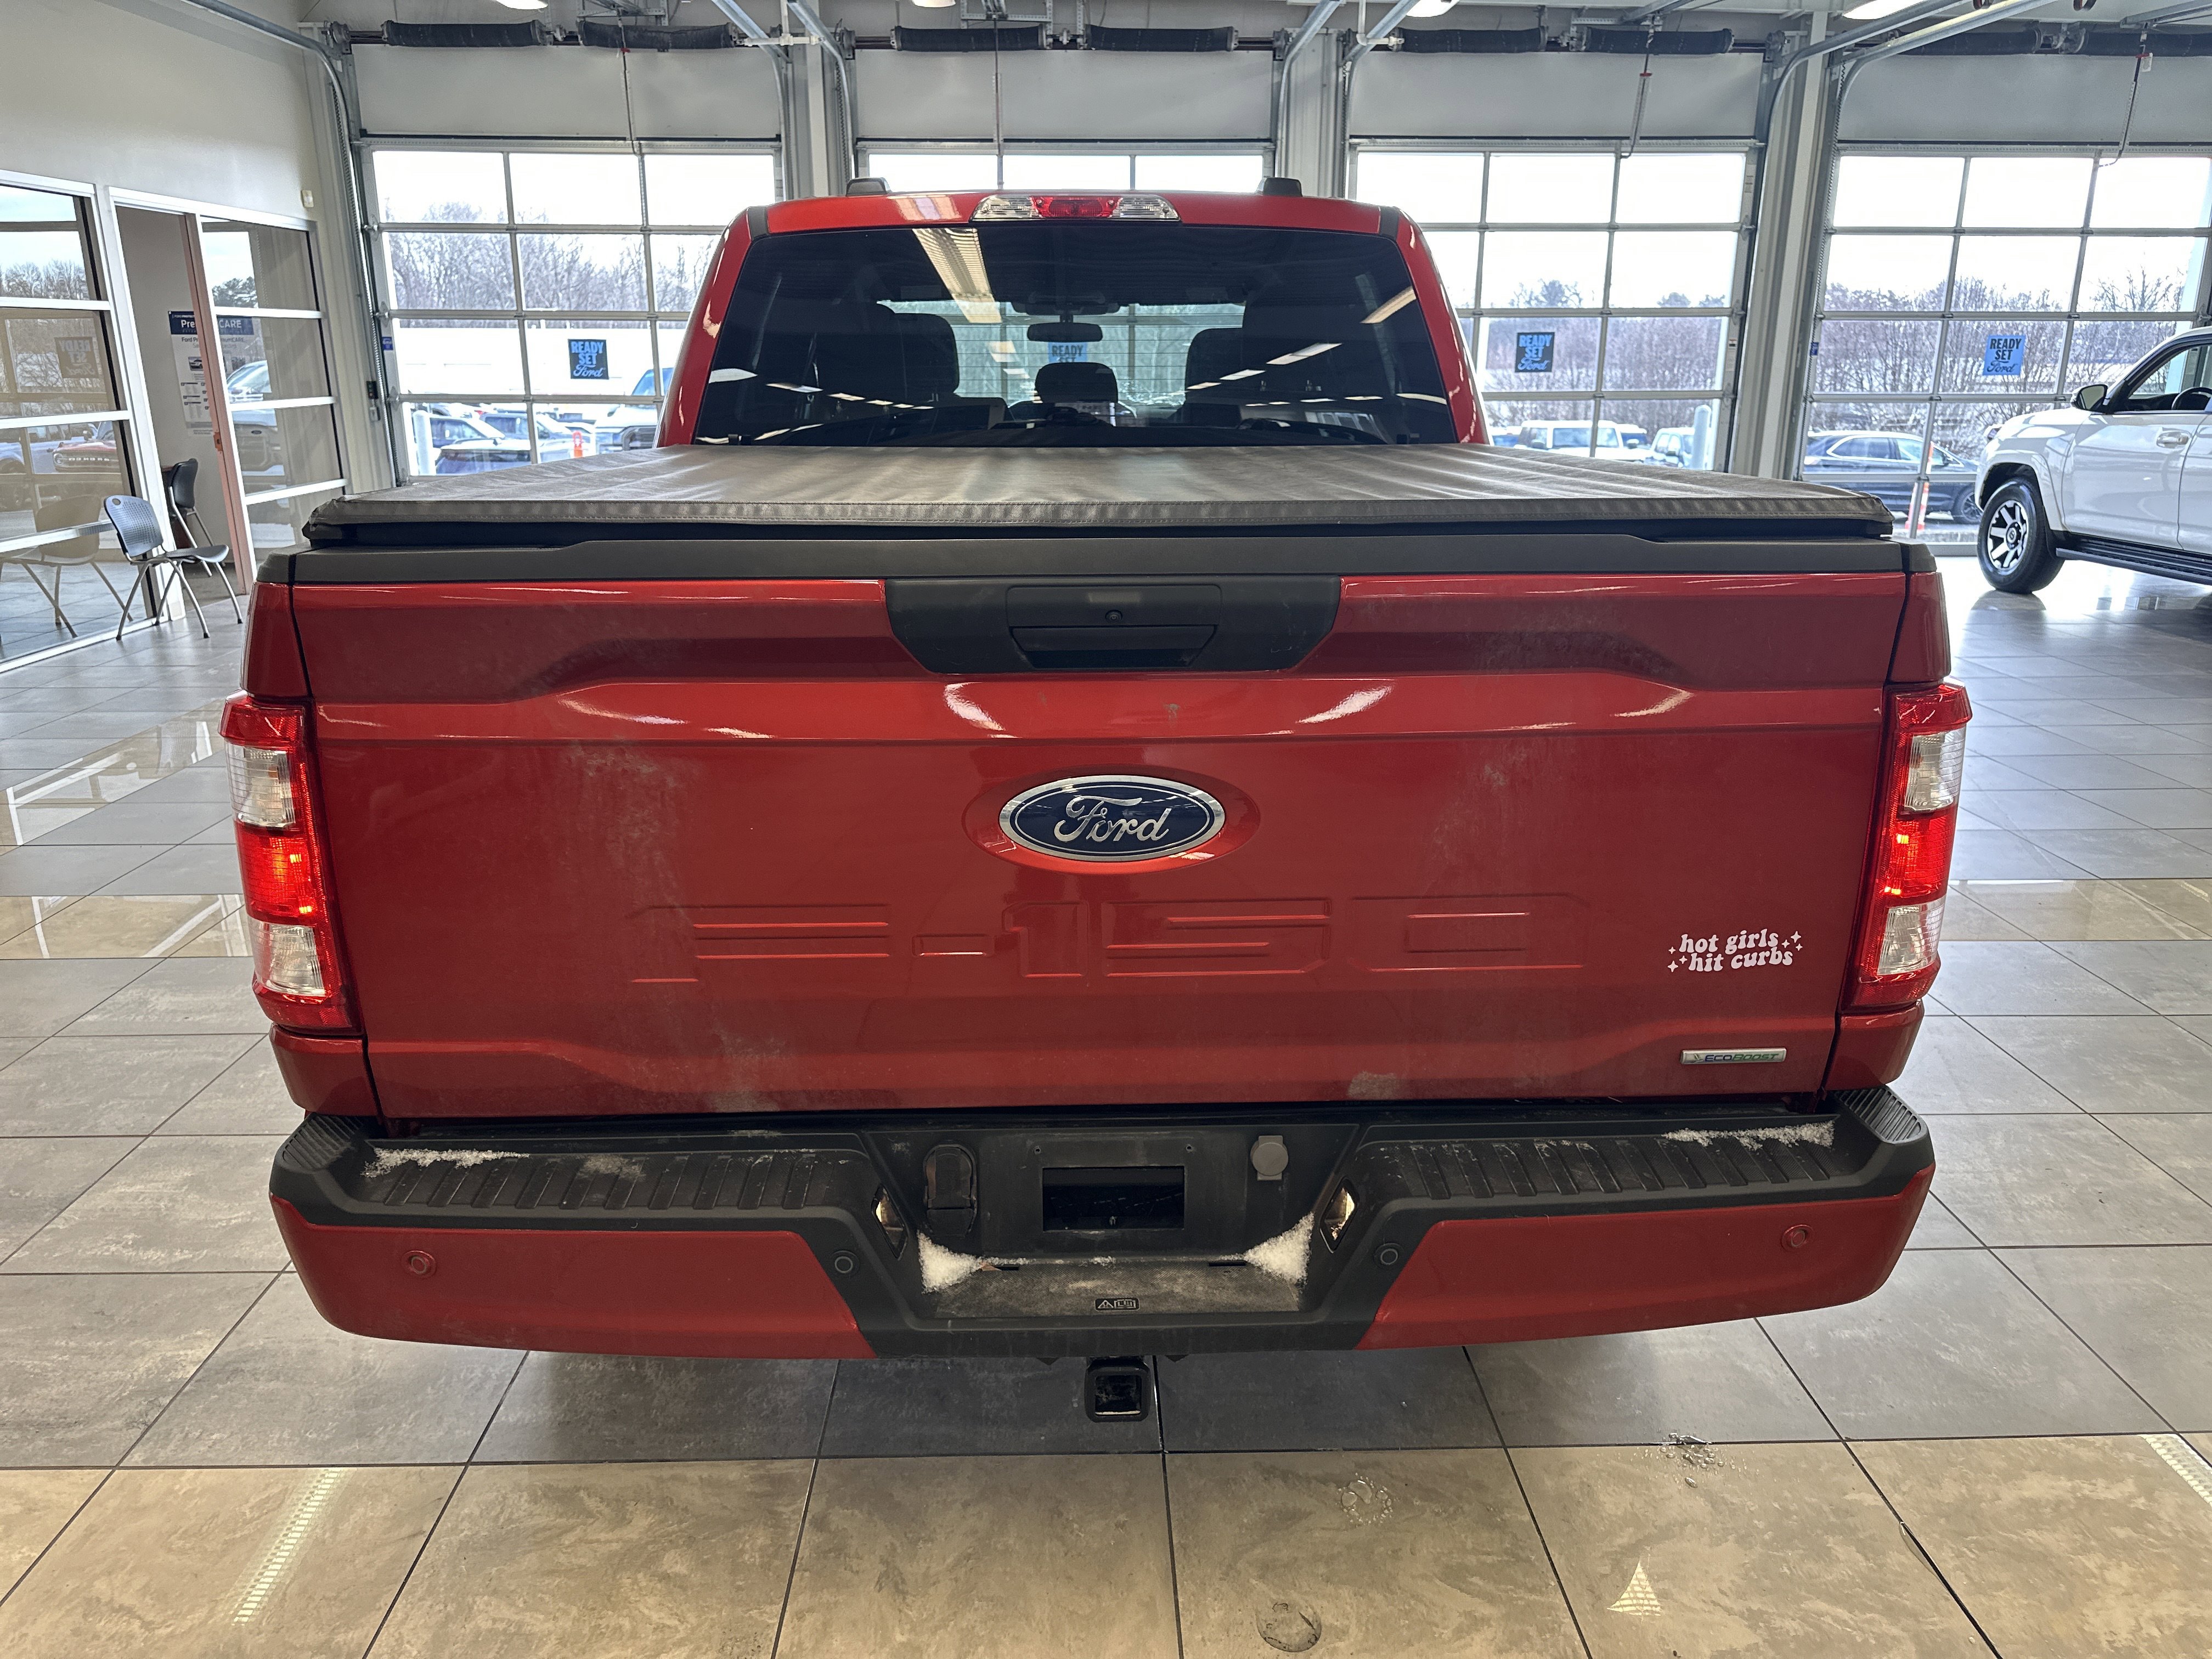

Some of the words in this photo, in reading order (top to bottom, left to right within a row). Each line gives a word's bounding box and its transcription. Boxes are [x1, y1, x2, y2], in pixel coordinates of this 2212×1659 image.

[571, 341, 603, 353] READY
[1519, 335, 1552, 347] READY
[1990, 338, 2022, 349] READY
[1052, 345, 1083, 357] READY
[1525, 346, 1544, 358] SET
[1995, 349, 2013, 360] SET
[579, 353, 597, 364] SET
[1517, 357, 1549, 370] Ford
[573, 364, 603, 377] Ford
[1987, 360, 2018, 373] Ford
[1054, 795, 1172, 842] Ford
[1679, 934, 1719, 953] hot
[1725, 928, 1779, 955] girls
[1688, 953, 1724, 972] hit
[1731, 946, 1793, 969] curbs
[1705, 1053, 1779, 1062] ECOBOOST
